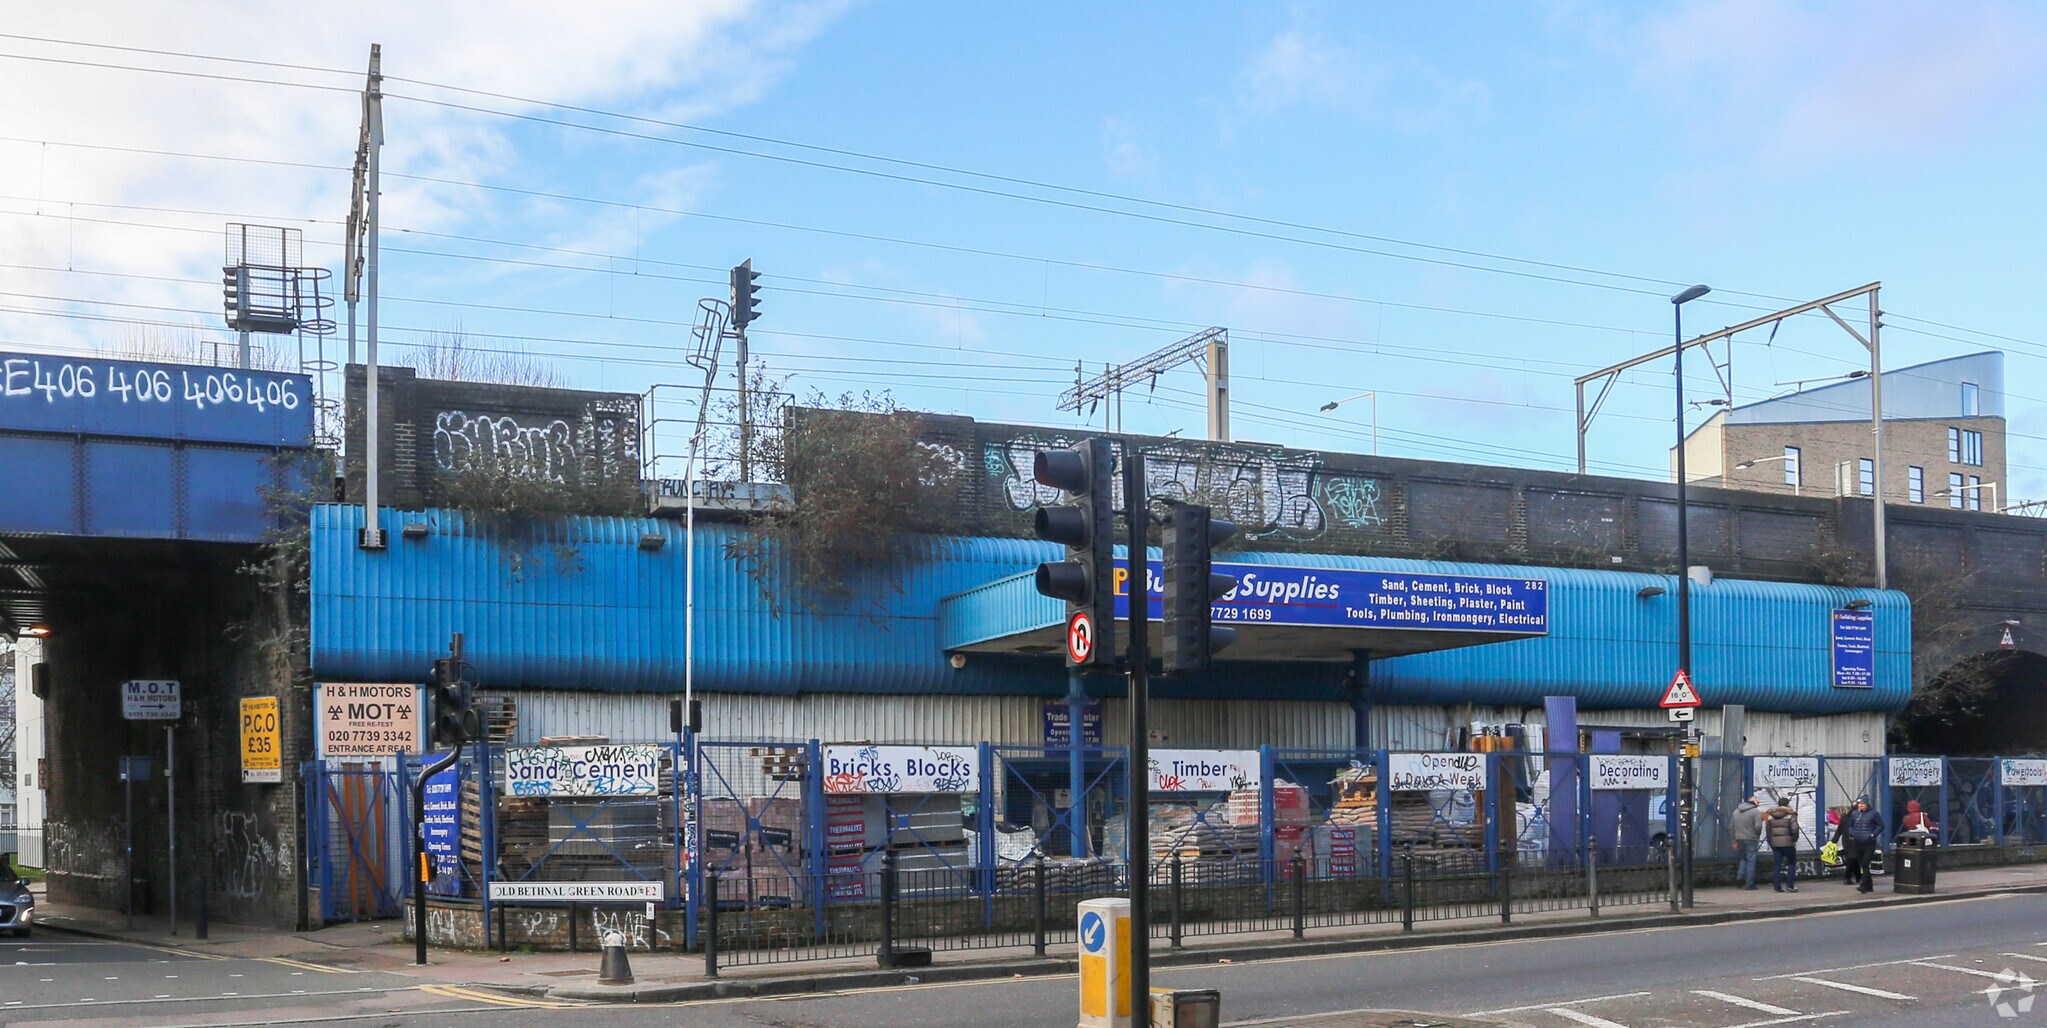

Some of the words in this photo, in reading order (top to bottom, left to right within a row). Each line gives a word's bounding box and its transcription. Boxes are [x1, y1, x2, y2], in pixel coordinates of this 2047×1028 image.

[108, 366, 172, 403] 406
[1240, 572, 1340, 604] Supplies
[1382, 579, 1408, 592] Sand,
[1411, 580, 1451, 594] Cement,
[1454, 584, 1483, 596] Brick,
[1486, 585, 1513, 596] Block
[1525, 581, 1544, 591] 282
[1369, 593, 1407, 607] Timber,
[1410, 595, 1456, 610] Sheeting,
[1459, 597, 1497, 611] Plaster,
[1500, 600, 1525, 611] Paint
[1242, 608, 1272, 621] 1699
[1346, 607, 1377, 621] Tools,
[1380, 609, 1430, 624] Plumbing,
[1433, 611, 1496, 626] Ironmongery,
[1499, 613, 1544, 626] Electrical
[128, 682, 175, 694] M.O.T
[359, 686, 412, 697] MOTORS
[348, 703, 396, 720] MOT
[1046, 712, 1068, 721] Trade
[243, 712, 276, 734] P.C.O
[328, 730, 349, 741] 020
[352, 730, 380, 742] 7739
[383, 730, 412, 742] 3342
[248, 736, 272, 753] £35
[328, 744, 374, 752] ENTRANCE
[376, 744, 386, 752] AT
[387, 744, 412, 753] REAR
[573, 758, 656, 779] Cement
[906, 758, 971, 777] Blocks
[1172, 760, 1228, 777] Timber
[1600, 764, 1659, 780] Decorating
[1768, 765, 1809, 780] Plumbing
[1893, 765, 1940, 780] Ironmongery
[2006, 765, 2043, 778] owertools
[1393, 772, 1400, 785] 6
[1449, 772, 1482, 786] Week
[829, 823, 863, 834] THERMALITE
[494, 886, 515, 896] OLD
[518, 886, 566, 896] BETHNAL
[568, 886, 605, 896] GREEN
[607, 886, 637, 896] ROAD
[645, 886, 657, 896] E2
